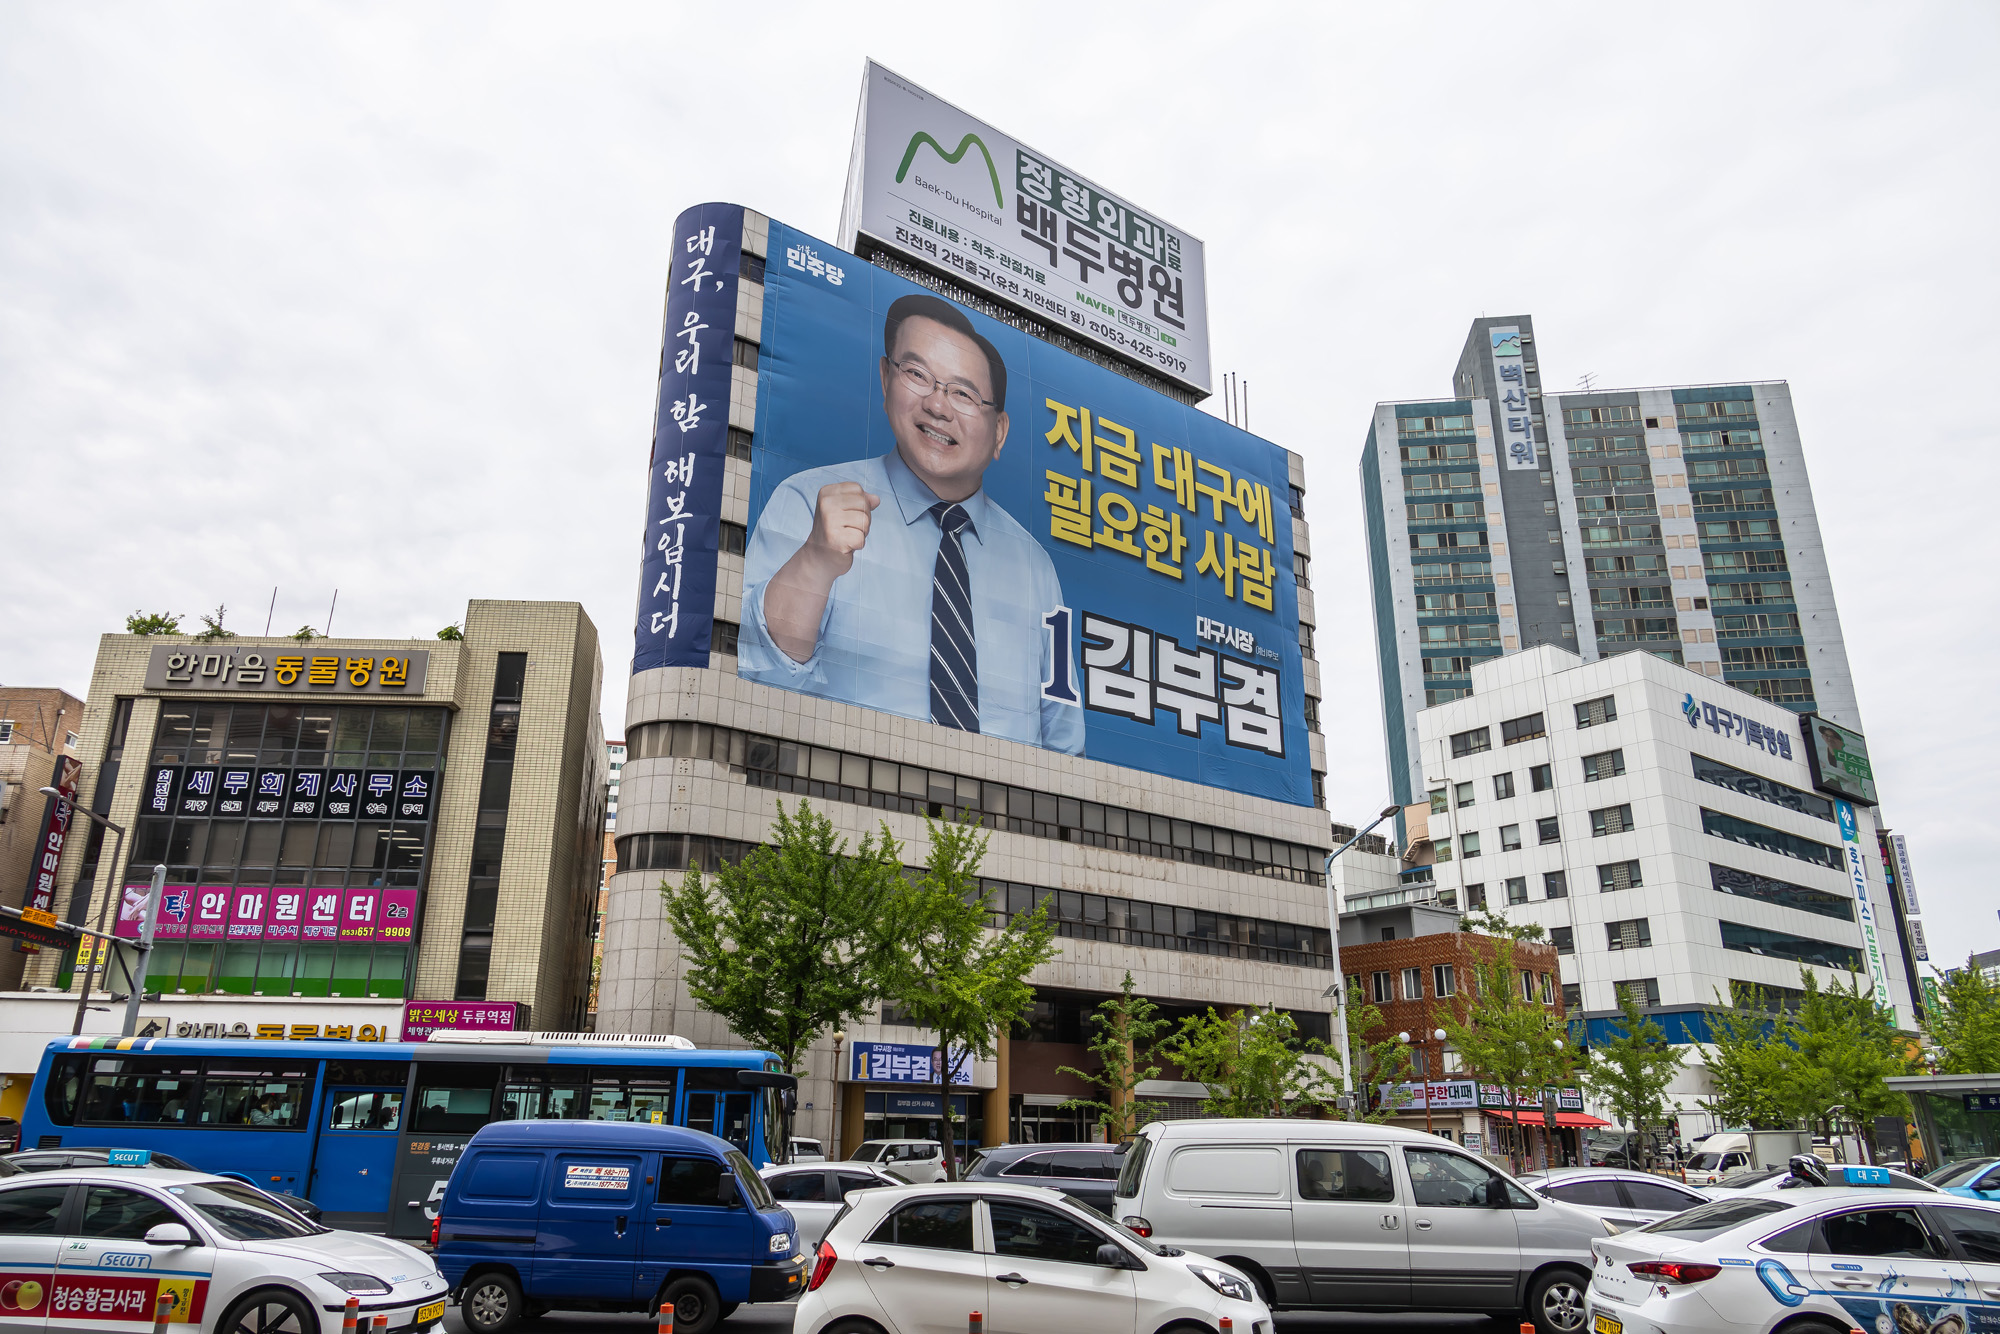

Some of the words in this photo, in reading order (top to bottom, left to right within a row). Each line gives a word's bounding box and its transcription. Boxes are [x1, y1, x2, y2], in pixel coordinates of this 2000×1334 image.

[915, 175, 959, 205] Baek-Du
[962, 198, 1002, 226] Hospital
[1020, 152, 1165, 264] 정형외과
[909, 209, 959, 244] 진료내용
[680, 225, 724, 293] 대구,
[786, 247, 845, 286] 민주당
[1016, 194, 1186, 331] 백두병원
[1167, 233, 1182, 273] 진료
[895, 226, 937, 257] 진천역
[941, 248, 1019, 295] 2번출구(유천
[1022, 287, 1067, 319] 치안센터
[1070, 310, 1086, 326] 옆)
[1100, 324, 1187, 374] 053-425-5919
[1076, 291, 1115, 317] NAVER
[1121, 313, 1151, 333] 백두병원
[675, 311, 709, 375] 우리
[670, 393, 707, 433] 함
[1499, 363, 1536, 466] 벽산타워
[1044, 398, 1142, 488] 지금
[1151, 442, 1274, 545] 대구에
[650, 452, 696, 639] 해보입시더
[1043, 469, 1187, 579] 필요한
[1195, 529, 1275, 612] 사람
[1196, 615, 1254, 654] 대구시장
[165, 652, 410, 687] 한마음동물병원
[1041, 604, 1080, 708] 1
[1081, 609, 1286, 759] 김부겸
[1701, 701, 1792, 761] 대구기독병원
[152, 769, 173, 811] 최진혁
[187, 770, 428, 798] 세무회계사무소
[185, 800, 207, 811] 기장
[220, 801, 242, 811] 신고
[257, 801, 279, 812] 세무
[292, 802, 315, 813] 조정
[329, 802, 350, 814] 양도
[366, 803, 387, 814] 상속
[402, 803, 424, 815] 증여
[32, 831, 63, 912] 안마원센
[200, 892, 374, 922] 안마원센터
[386, 903, 409, 918] 2층
[1849, 846, 1871, 921] 호스피스
[1864, 924, 1888, 1004] 전문기관
[267, 925, 298, 937] 바우처
[303, 925, 337, 937] 제공기관
[409, 1008, 459, 1024] 밝은세상
[461, 1010, 511, 1024] 두류역점
[857, 1051, 869, 1080] 1
[871, 1053, 931, 1081] 김부겸
[872, 1044, 892, 1053] 대구시장
[1427, 1084, 1473, 1100] 무한대패
[1857, 1170, 1880, 1181] 대구
[53, 1285, 147, 1313] 청송황금사과
